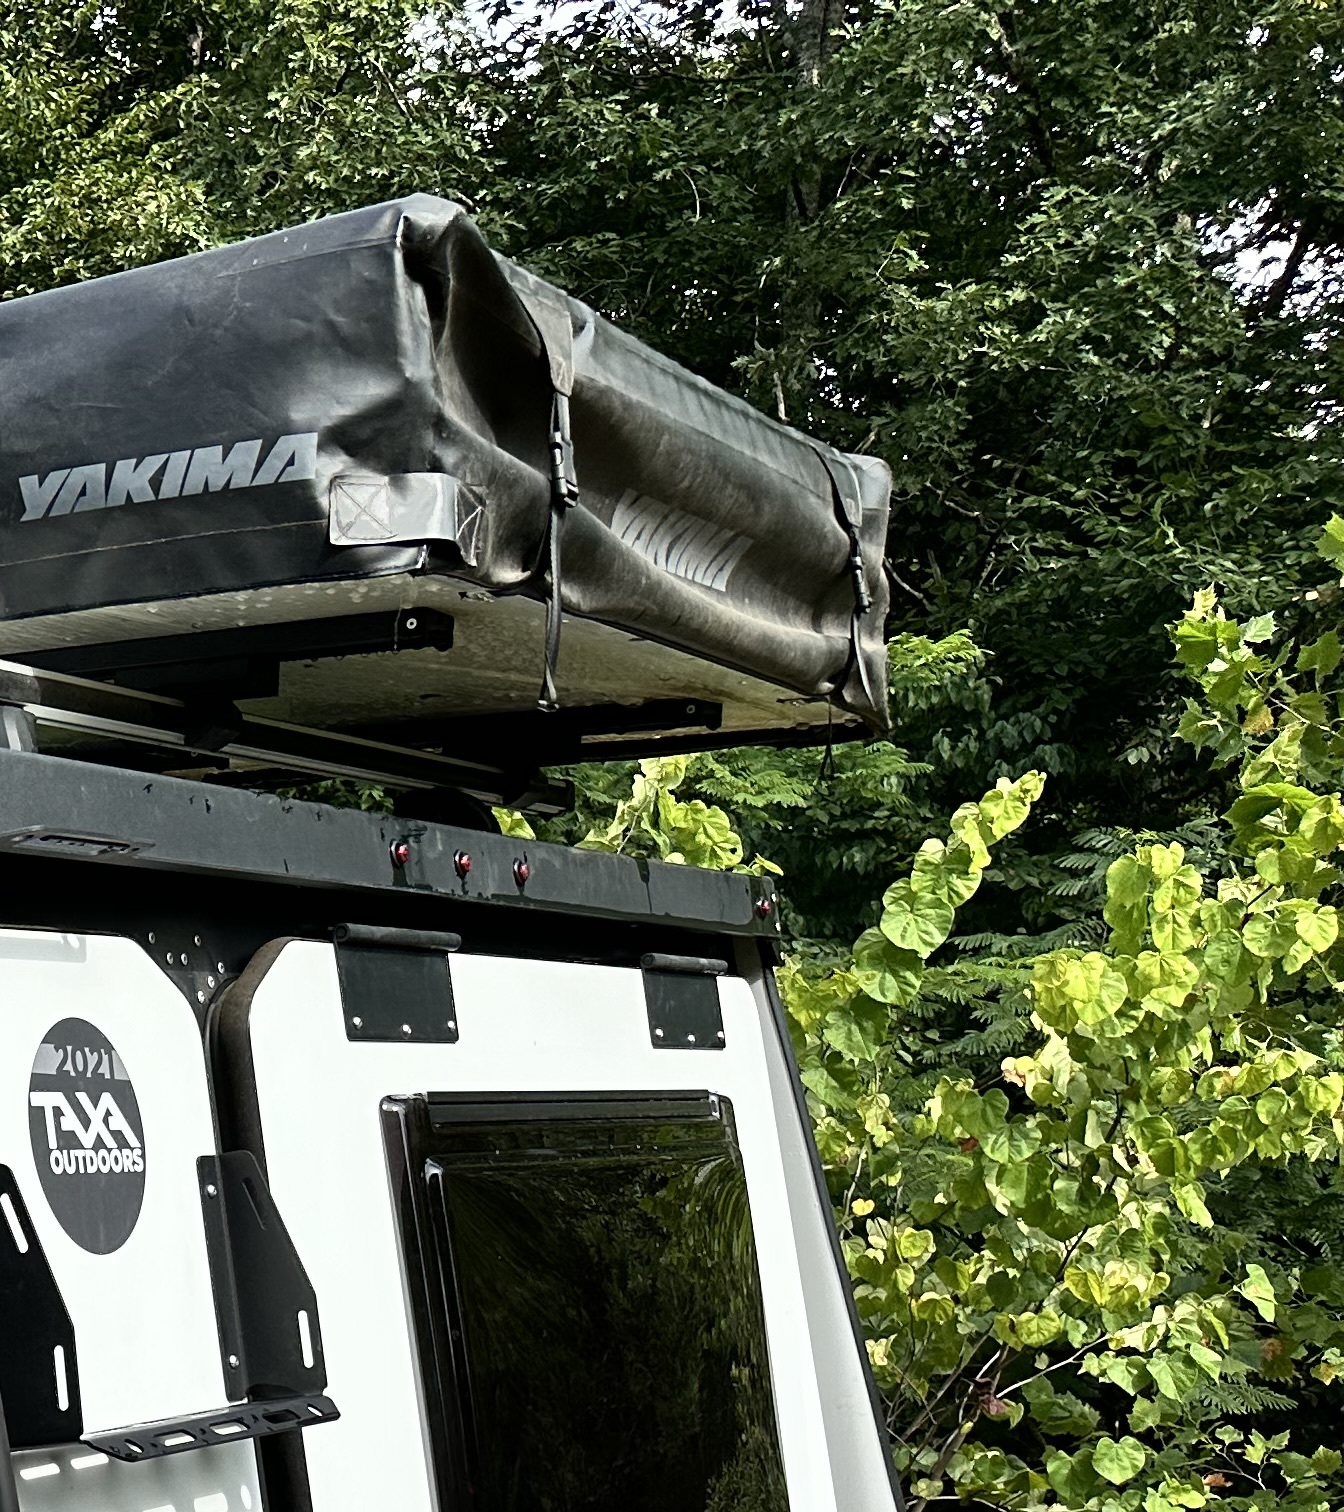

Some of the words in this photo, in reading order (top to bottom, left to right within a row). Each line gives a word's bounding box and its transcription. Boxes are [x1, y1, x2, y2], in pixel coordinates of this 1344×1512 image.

[18, 432, 318, 523] YAKIMA
[55, 1046, 115, 1079] 2021
[29, 1091, 142, 1149] TAXA
[50, 1148, 144, 1174] OUTDOORS
